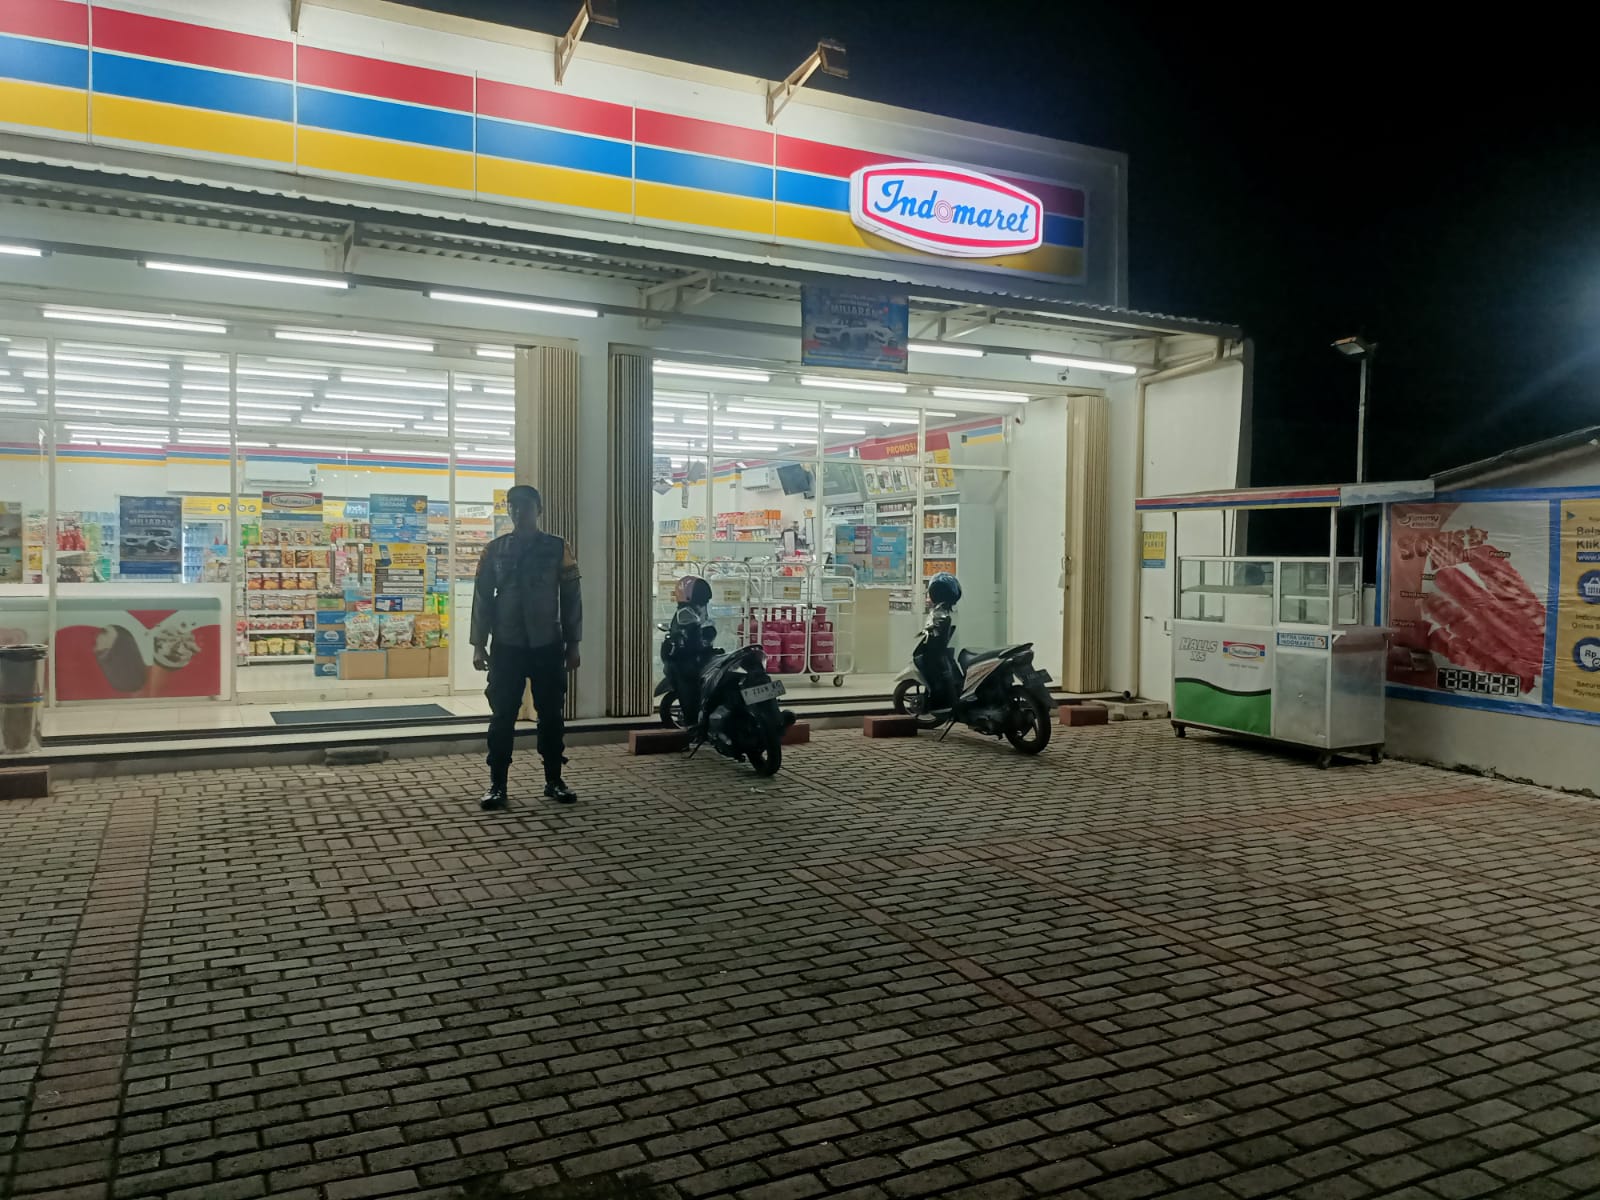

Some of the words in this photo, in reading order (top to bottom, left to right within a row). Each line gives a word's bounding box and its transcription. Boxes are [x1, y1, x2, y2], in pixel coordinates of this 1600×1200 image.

[874, 181, 1030, 233] Indomaret
[1178, 637, 1219, 654] HALLS
[1585, 649, 1597, 658] Rp
